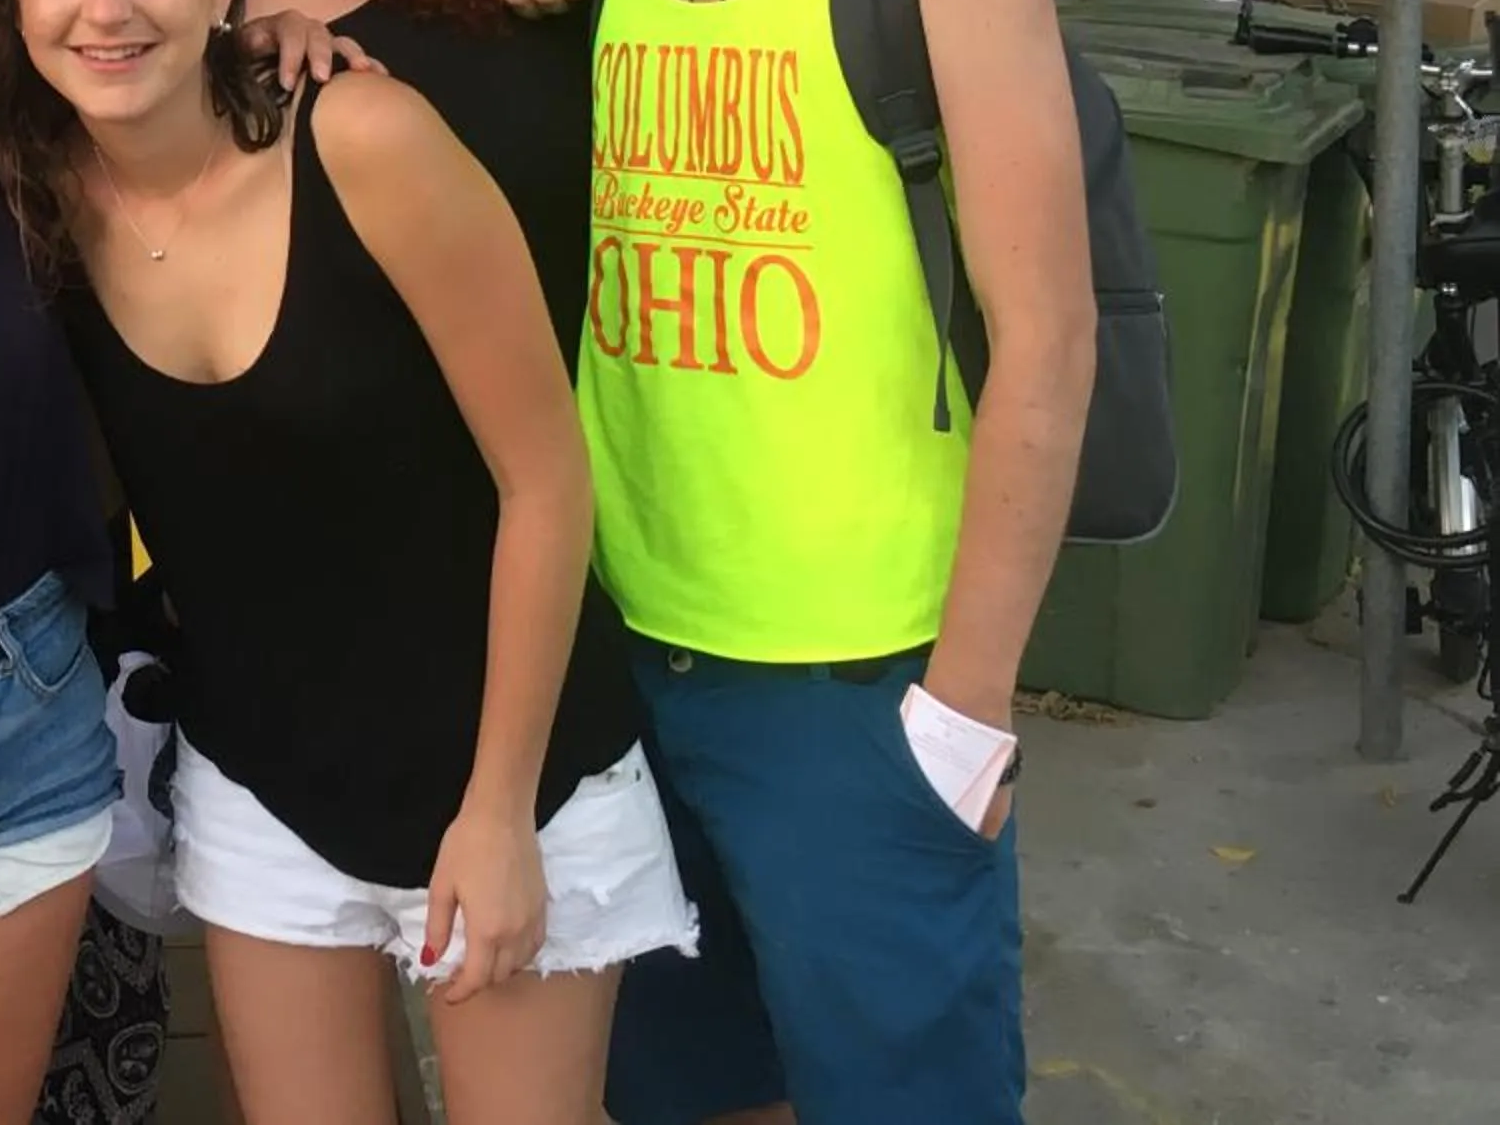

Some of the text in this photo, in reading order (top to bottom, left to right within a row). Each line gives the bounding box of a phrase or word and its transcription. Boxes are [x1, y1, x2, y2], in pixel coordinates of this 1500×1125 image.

[592, 43, 804, 185] COLUMBUS
[593, 171, 810, 233] Buckeye State
[591, 236, 820, 379] OHIO
